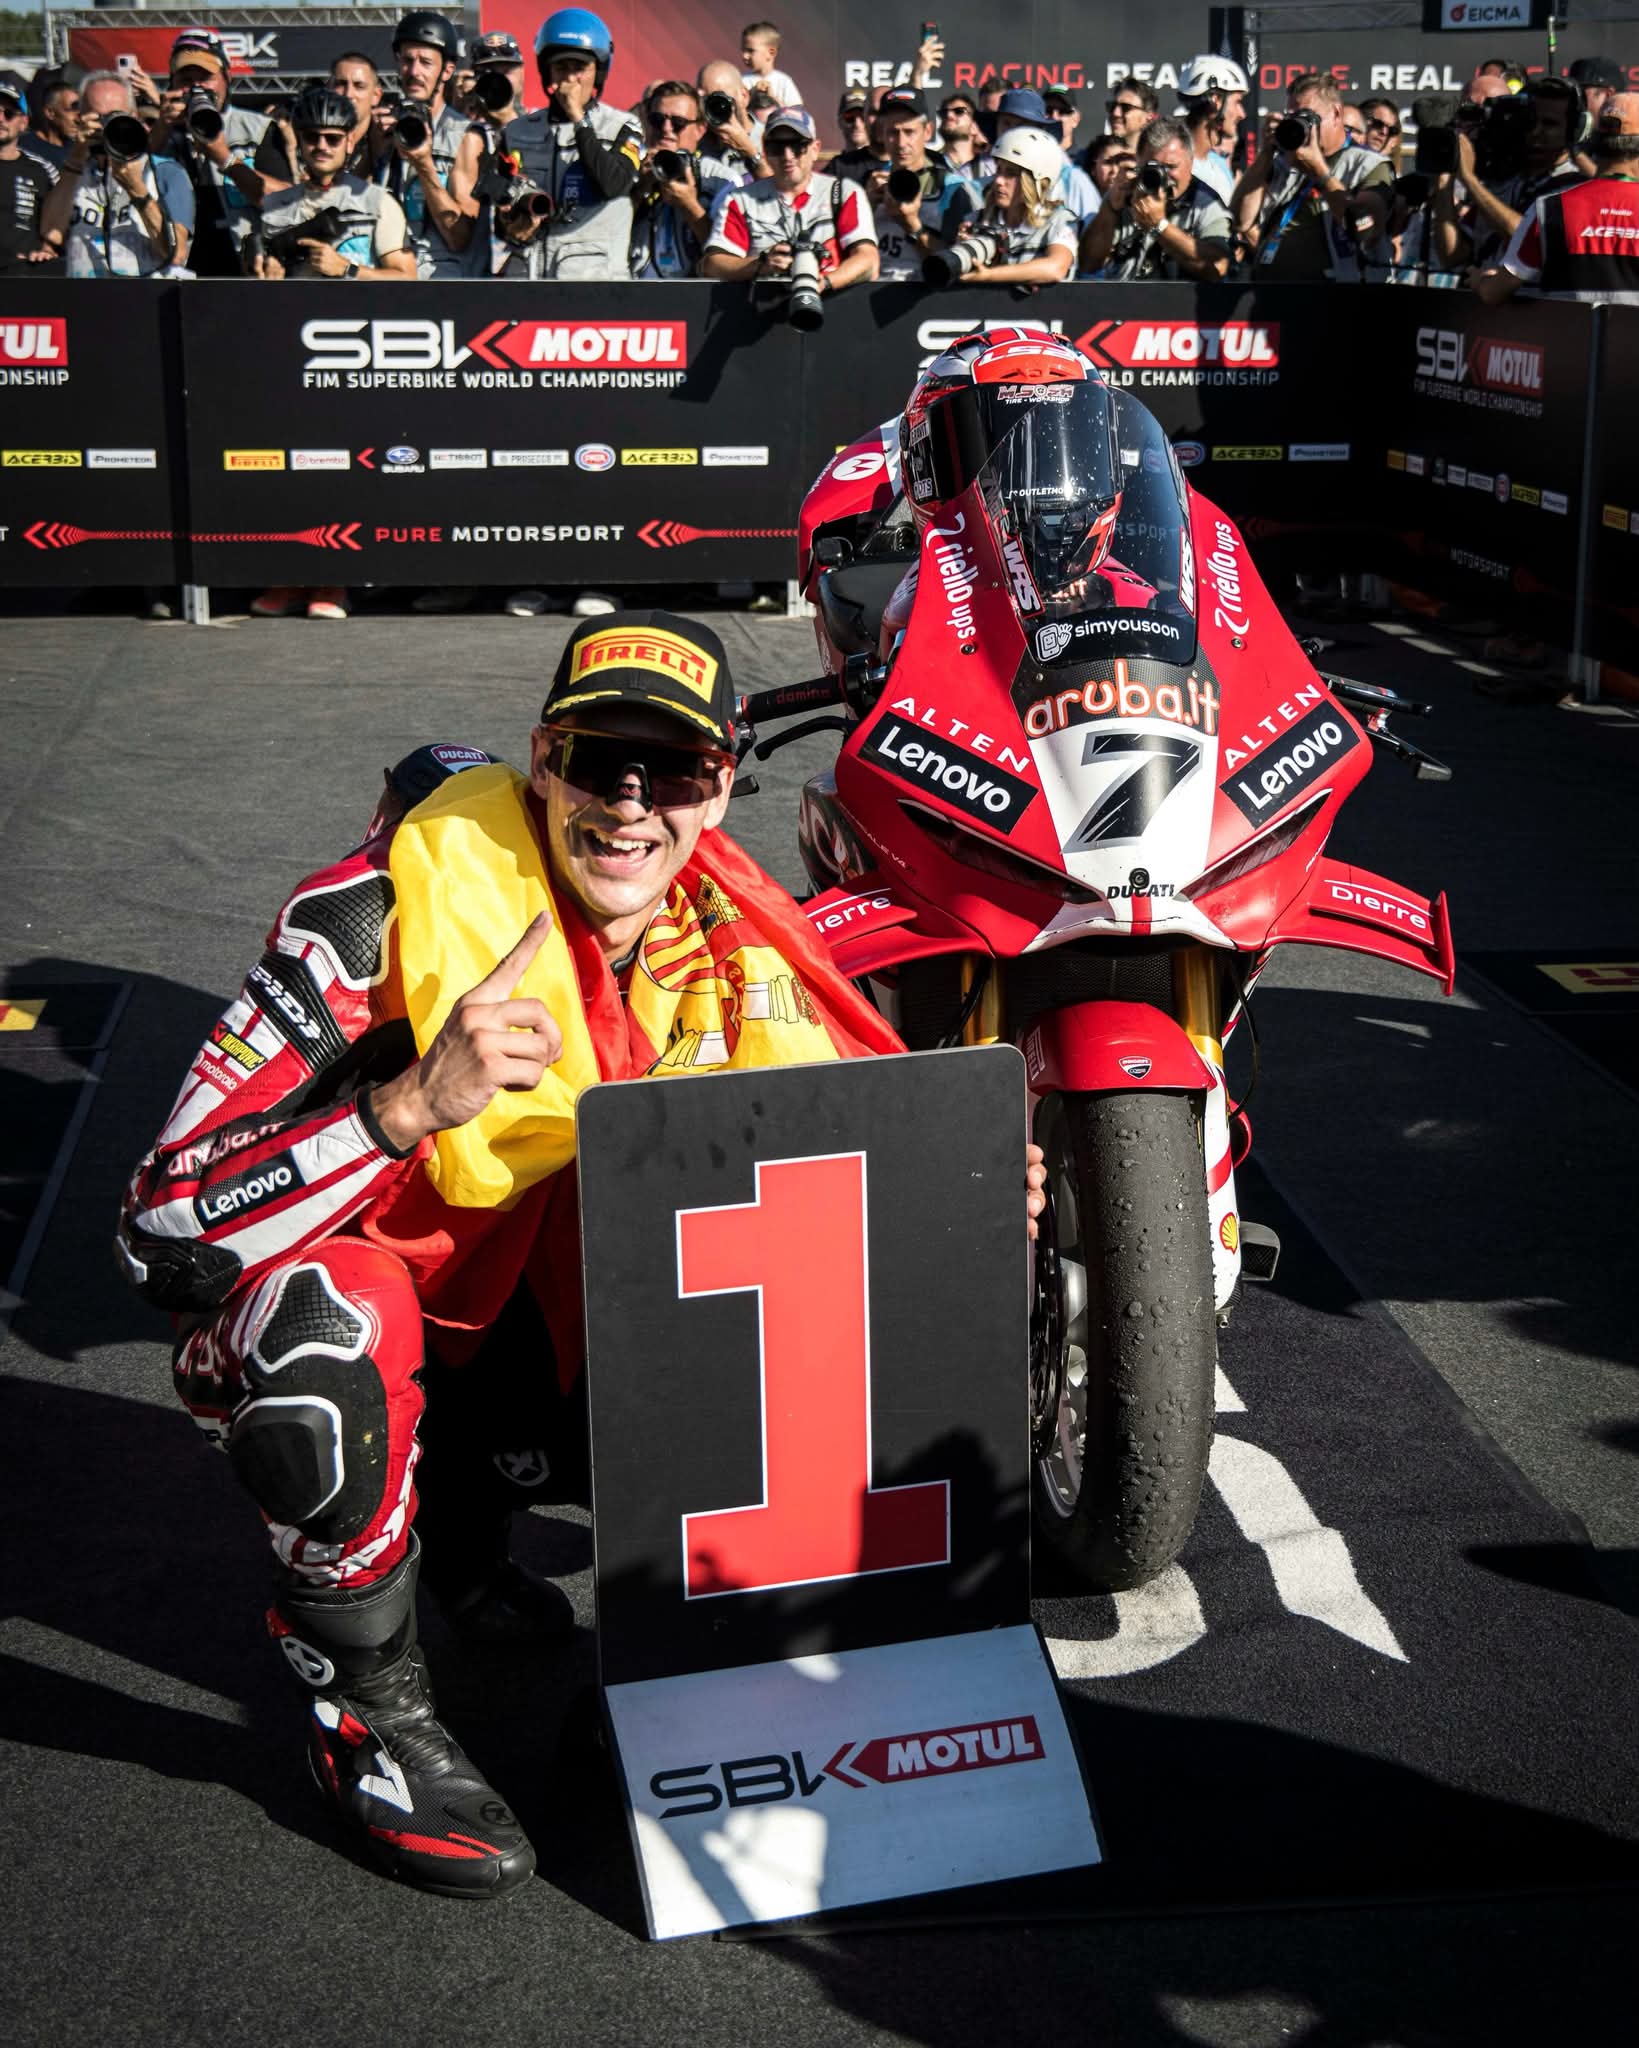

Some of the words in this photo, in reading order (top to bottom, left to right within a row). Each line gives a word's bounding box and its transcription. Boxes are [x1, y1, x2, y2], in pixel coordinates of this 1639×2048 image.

[1468, 5, 1521, 22] EICMA
[1370, 64, 1464, 91] REAL
[529, 327, 680, 362] MOTUL
[1131, 327, 1275, 361] MOTUL
[303, 371, 340, 389] FIM
[346, 371, 457, 389] SUPERBIKE
[462, 371, 533, 389] WORLD
[540, 371, 687, 389] CHAMPIONSHIP
[1140, 369, 1280, 387] CHAMPIONSHIP
[1486, 345, 1542, 389] MOTUL
[7, 454, 80, 465] ACERBIS
[625, 452, 694, 464] ACERBIS
[375, 528, 443, 543] PURE
[452, 525, 625, 543] MOTORSPORT
[1003, 540, 1041, 611] WRS
[1075, 619, 1180, 641] simyousoon
[579, 634, 707, 687] PIRELLI
[1023, 658, 1220, 738] aruba.it
[890, 697, 1030, 774] ALTEN
[1224, 683, 1322, 770] ALTEN
[438, 749, 483, 762] DUCATI
[877, 725, 1011, 812] Lenovo
[1238, 721, 1343, 810] Lenovo
[1061, 730, 1204, 855] 7
[1331, 885, 1427, 929] Dierre
[201, 1060, 238, 1091] motorola
[201, 1166, 292, 1222] Lenovo
[676, 1151, 951, 1600] 1
[887, 1723, 1035, 1777] MOTUL
